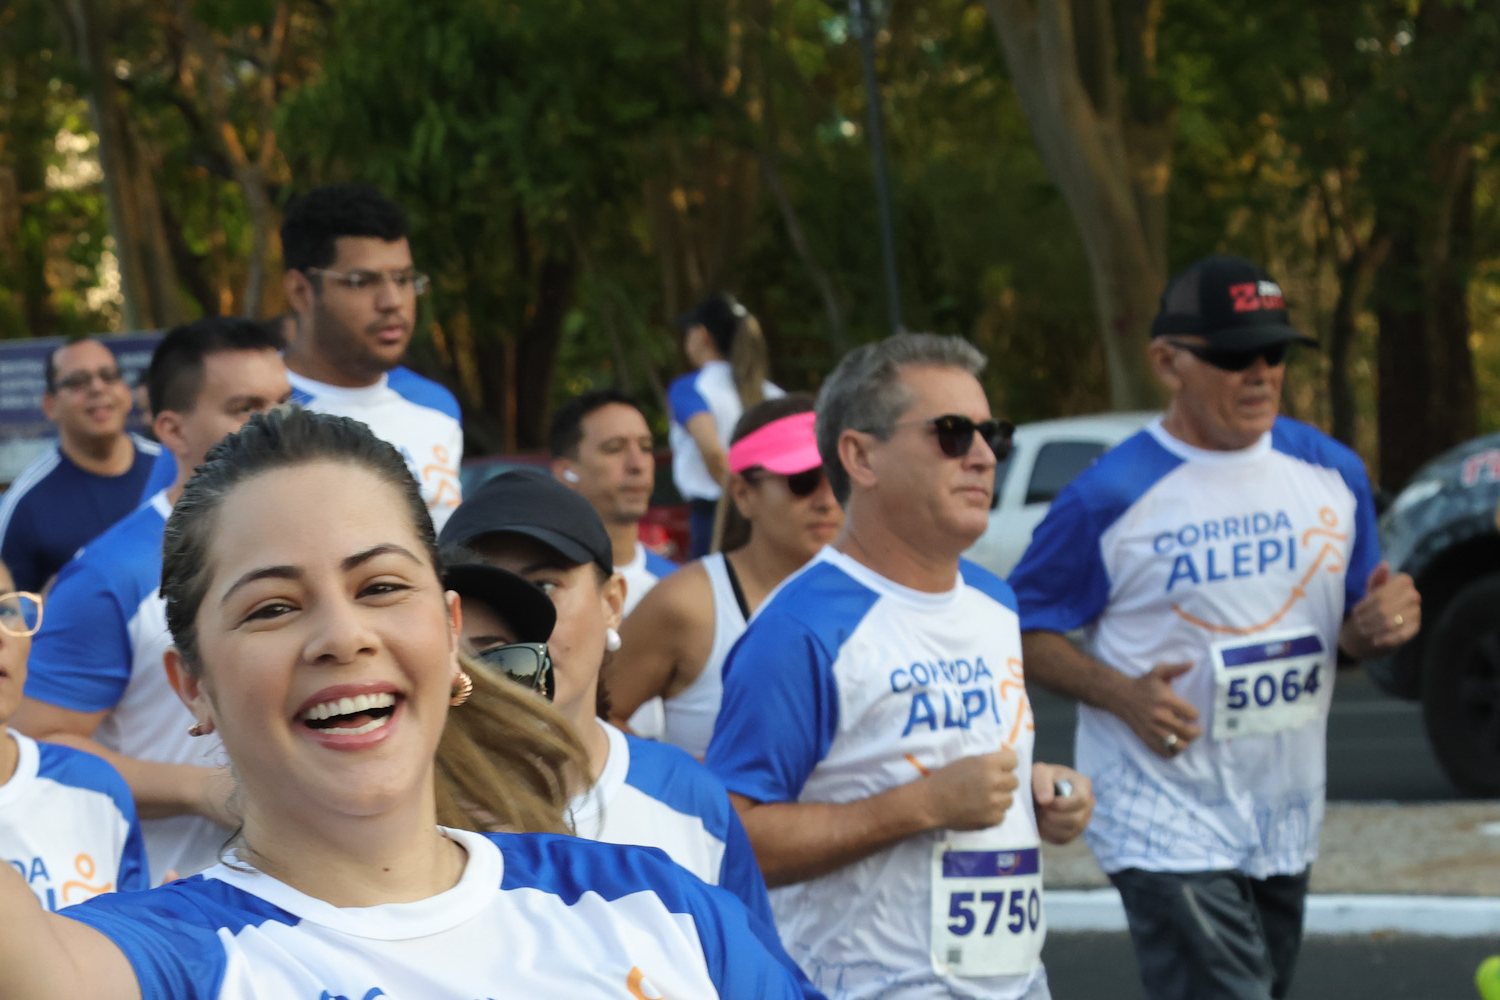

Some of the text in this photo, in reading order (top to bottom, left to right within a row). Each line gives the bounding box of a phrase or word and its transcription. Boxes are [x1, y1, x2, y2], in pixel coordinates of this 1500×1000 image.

[1153, 510, 1293, 554] CORRIDA
[1166, 536, 1297, 592] ALEPI
[1227, 664, 1321, 711] 5064
[947, 888, 1040, 936] 5750
